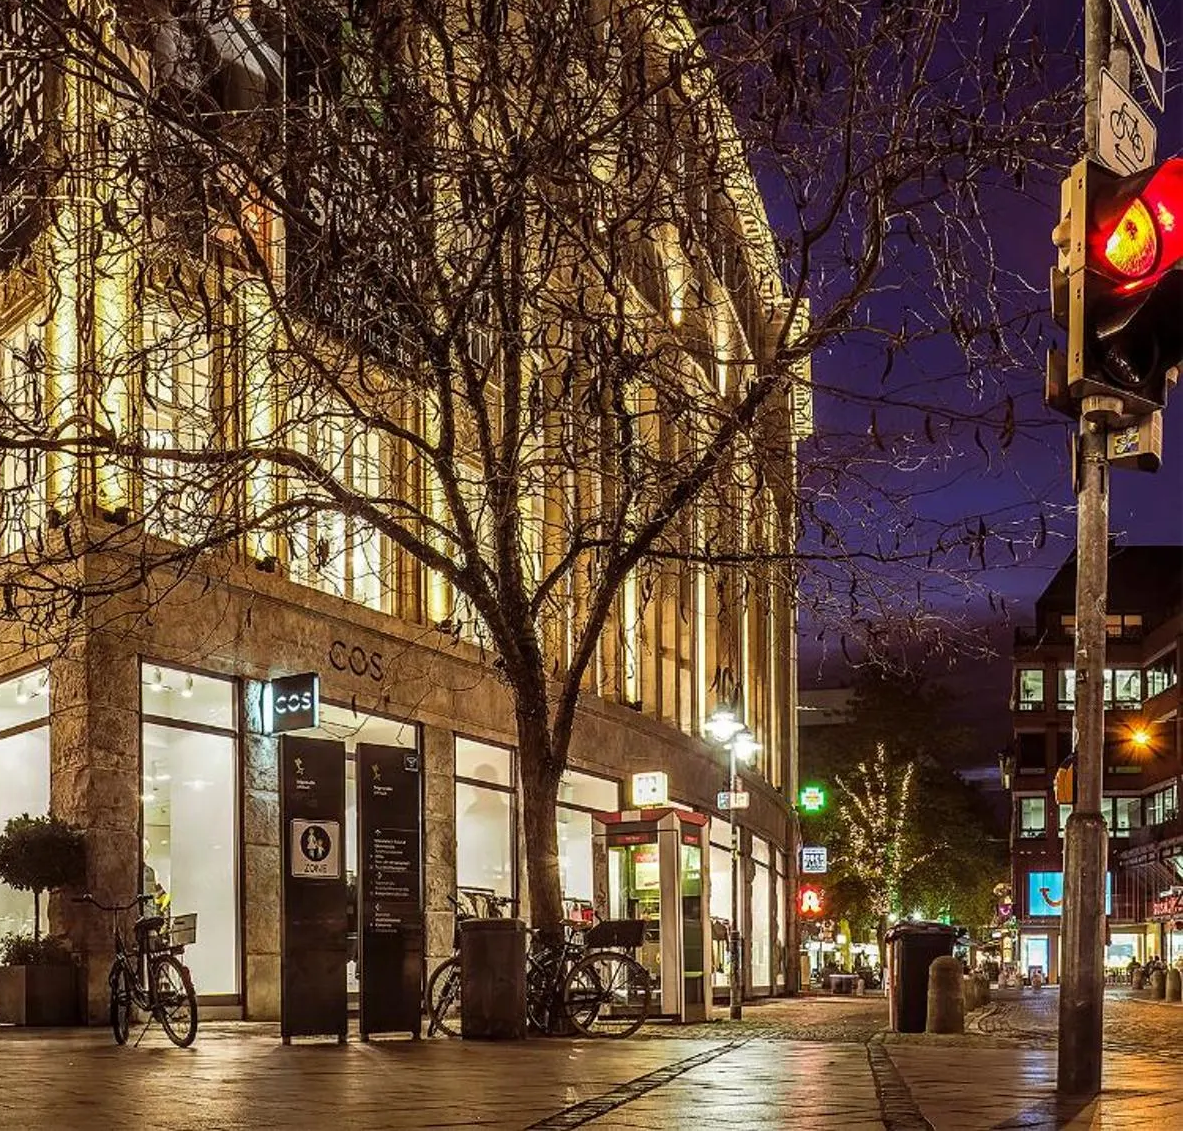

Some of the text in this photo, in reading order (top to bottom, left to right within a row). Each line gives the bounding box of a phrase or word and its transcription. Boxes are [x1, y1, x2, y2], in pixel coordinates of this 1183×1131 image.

[329, 640, 384, 682] COS
[275, 692, 312, 714] COS
[304, 863, 328, 874] ZONE
